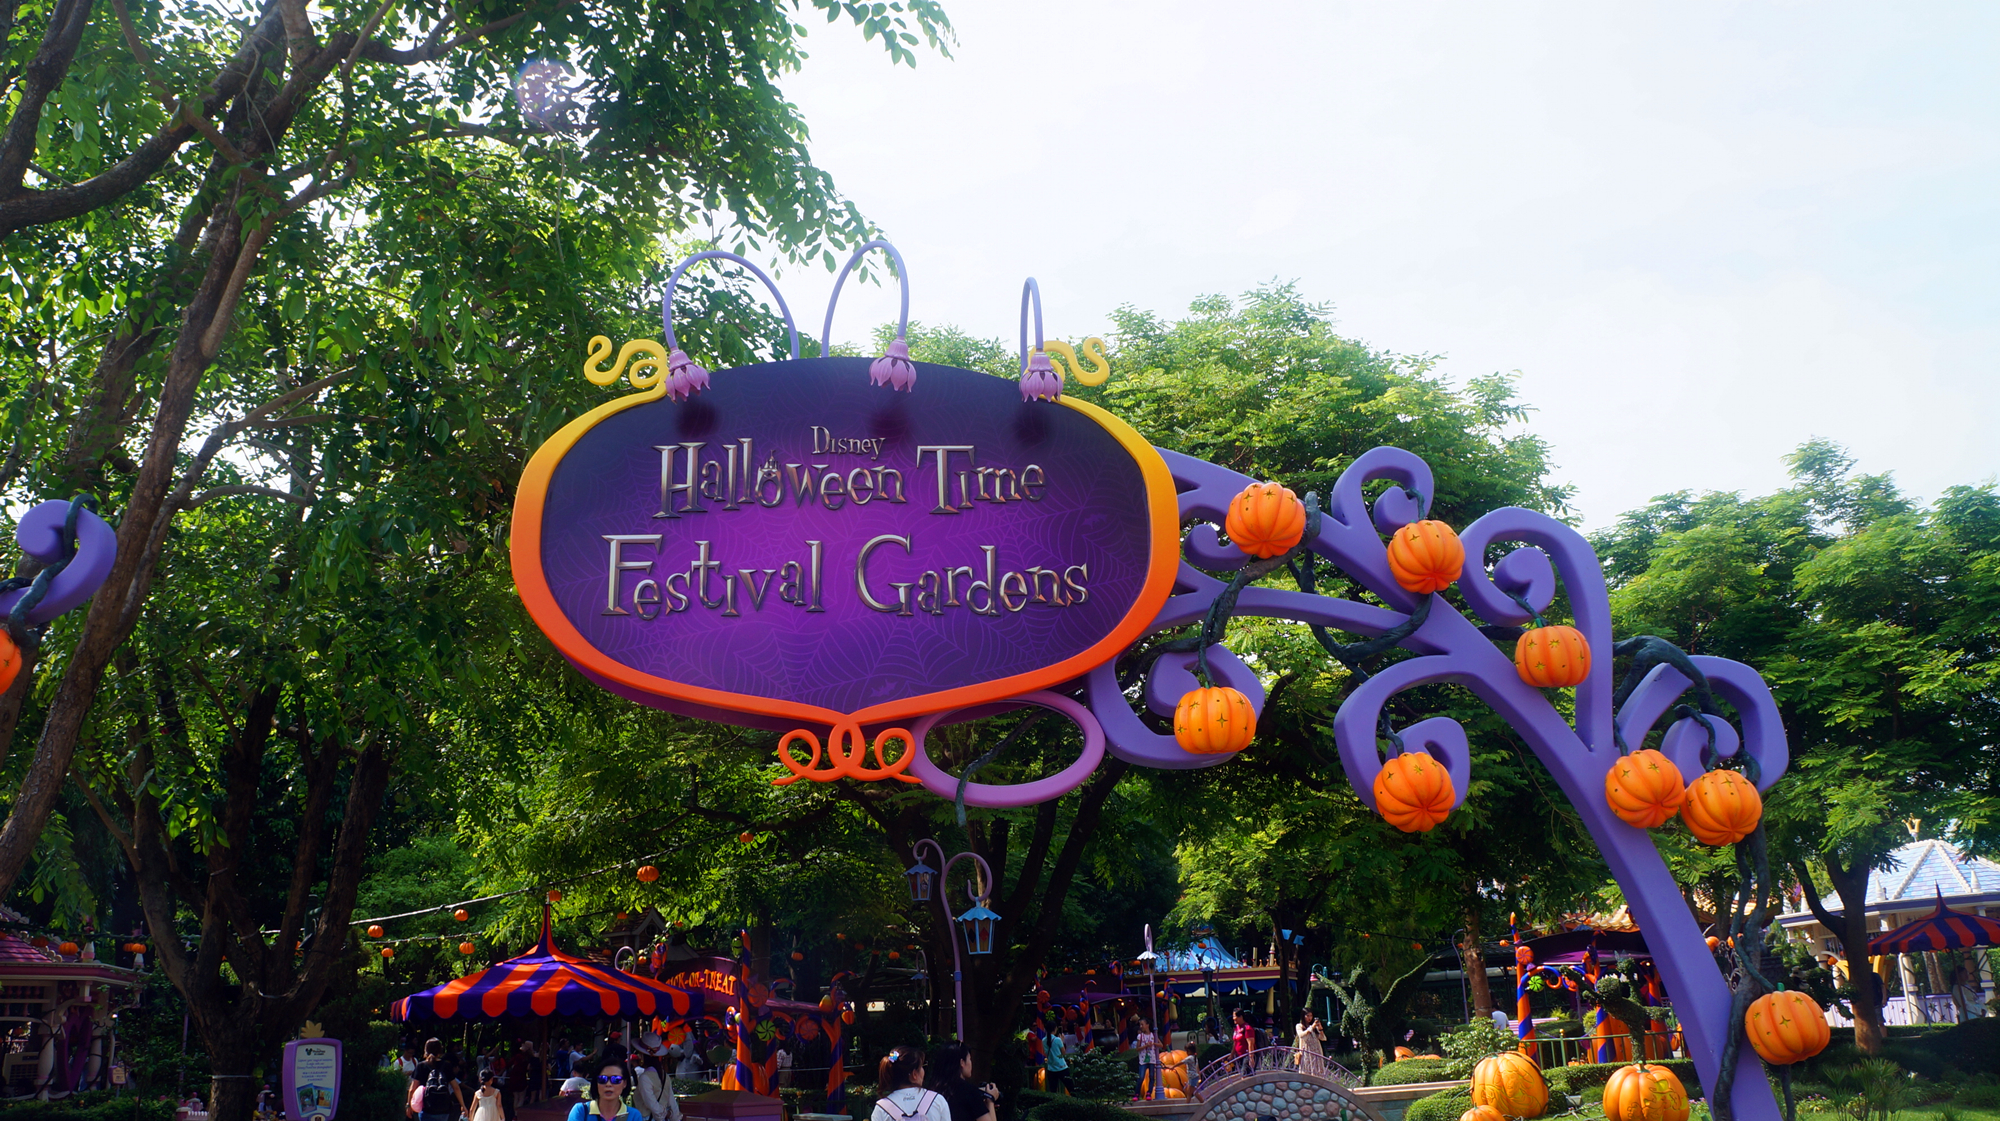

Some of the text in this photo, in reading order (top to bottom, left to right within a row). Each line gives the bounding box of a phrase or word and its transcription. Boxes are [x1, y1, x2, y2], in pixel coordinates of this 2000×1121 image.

[652, 437, 1046, 519] Halloween Time
[810, 425, 886, 460] Disney
[601, 532, 1089, 621] Festival Gardens
